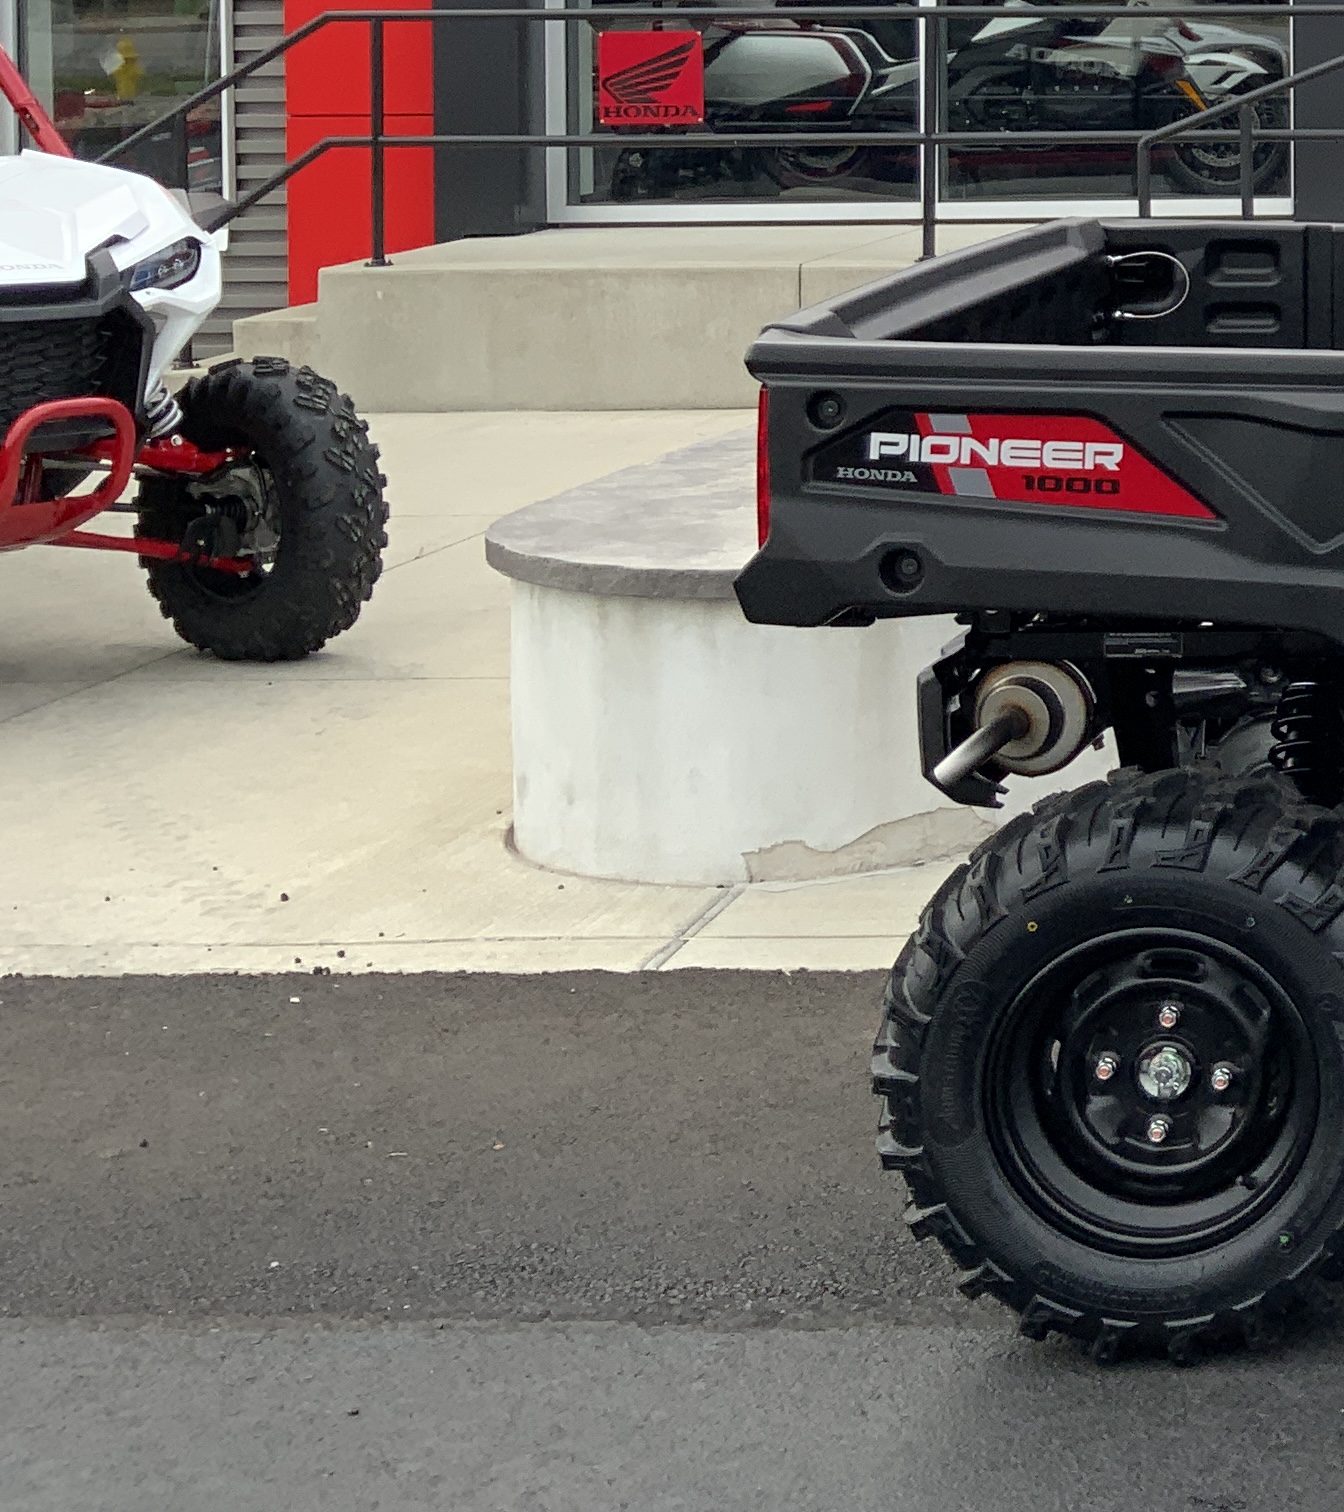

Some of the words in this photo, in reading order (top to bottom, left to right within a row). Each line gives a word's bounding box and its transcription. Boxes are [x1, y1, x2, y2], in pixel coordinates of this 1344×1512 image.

[603, 105, 698, 118] HONDA
[0, 263, 64, 271] ONDA
[868, 432, 1124, 471] PIONEER
[836, 467, 918, 483] HONDA
[1021, 474, 1120, 495] 1000
